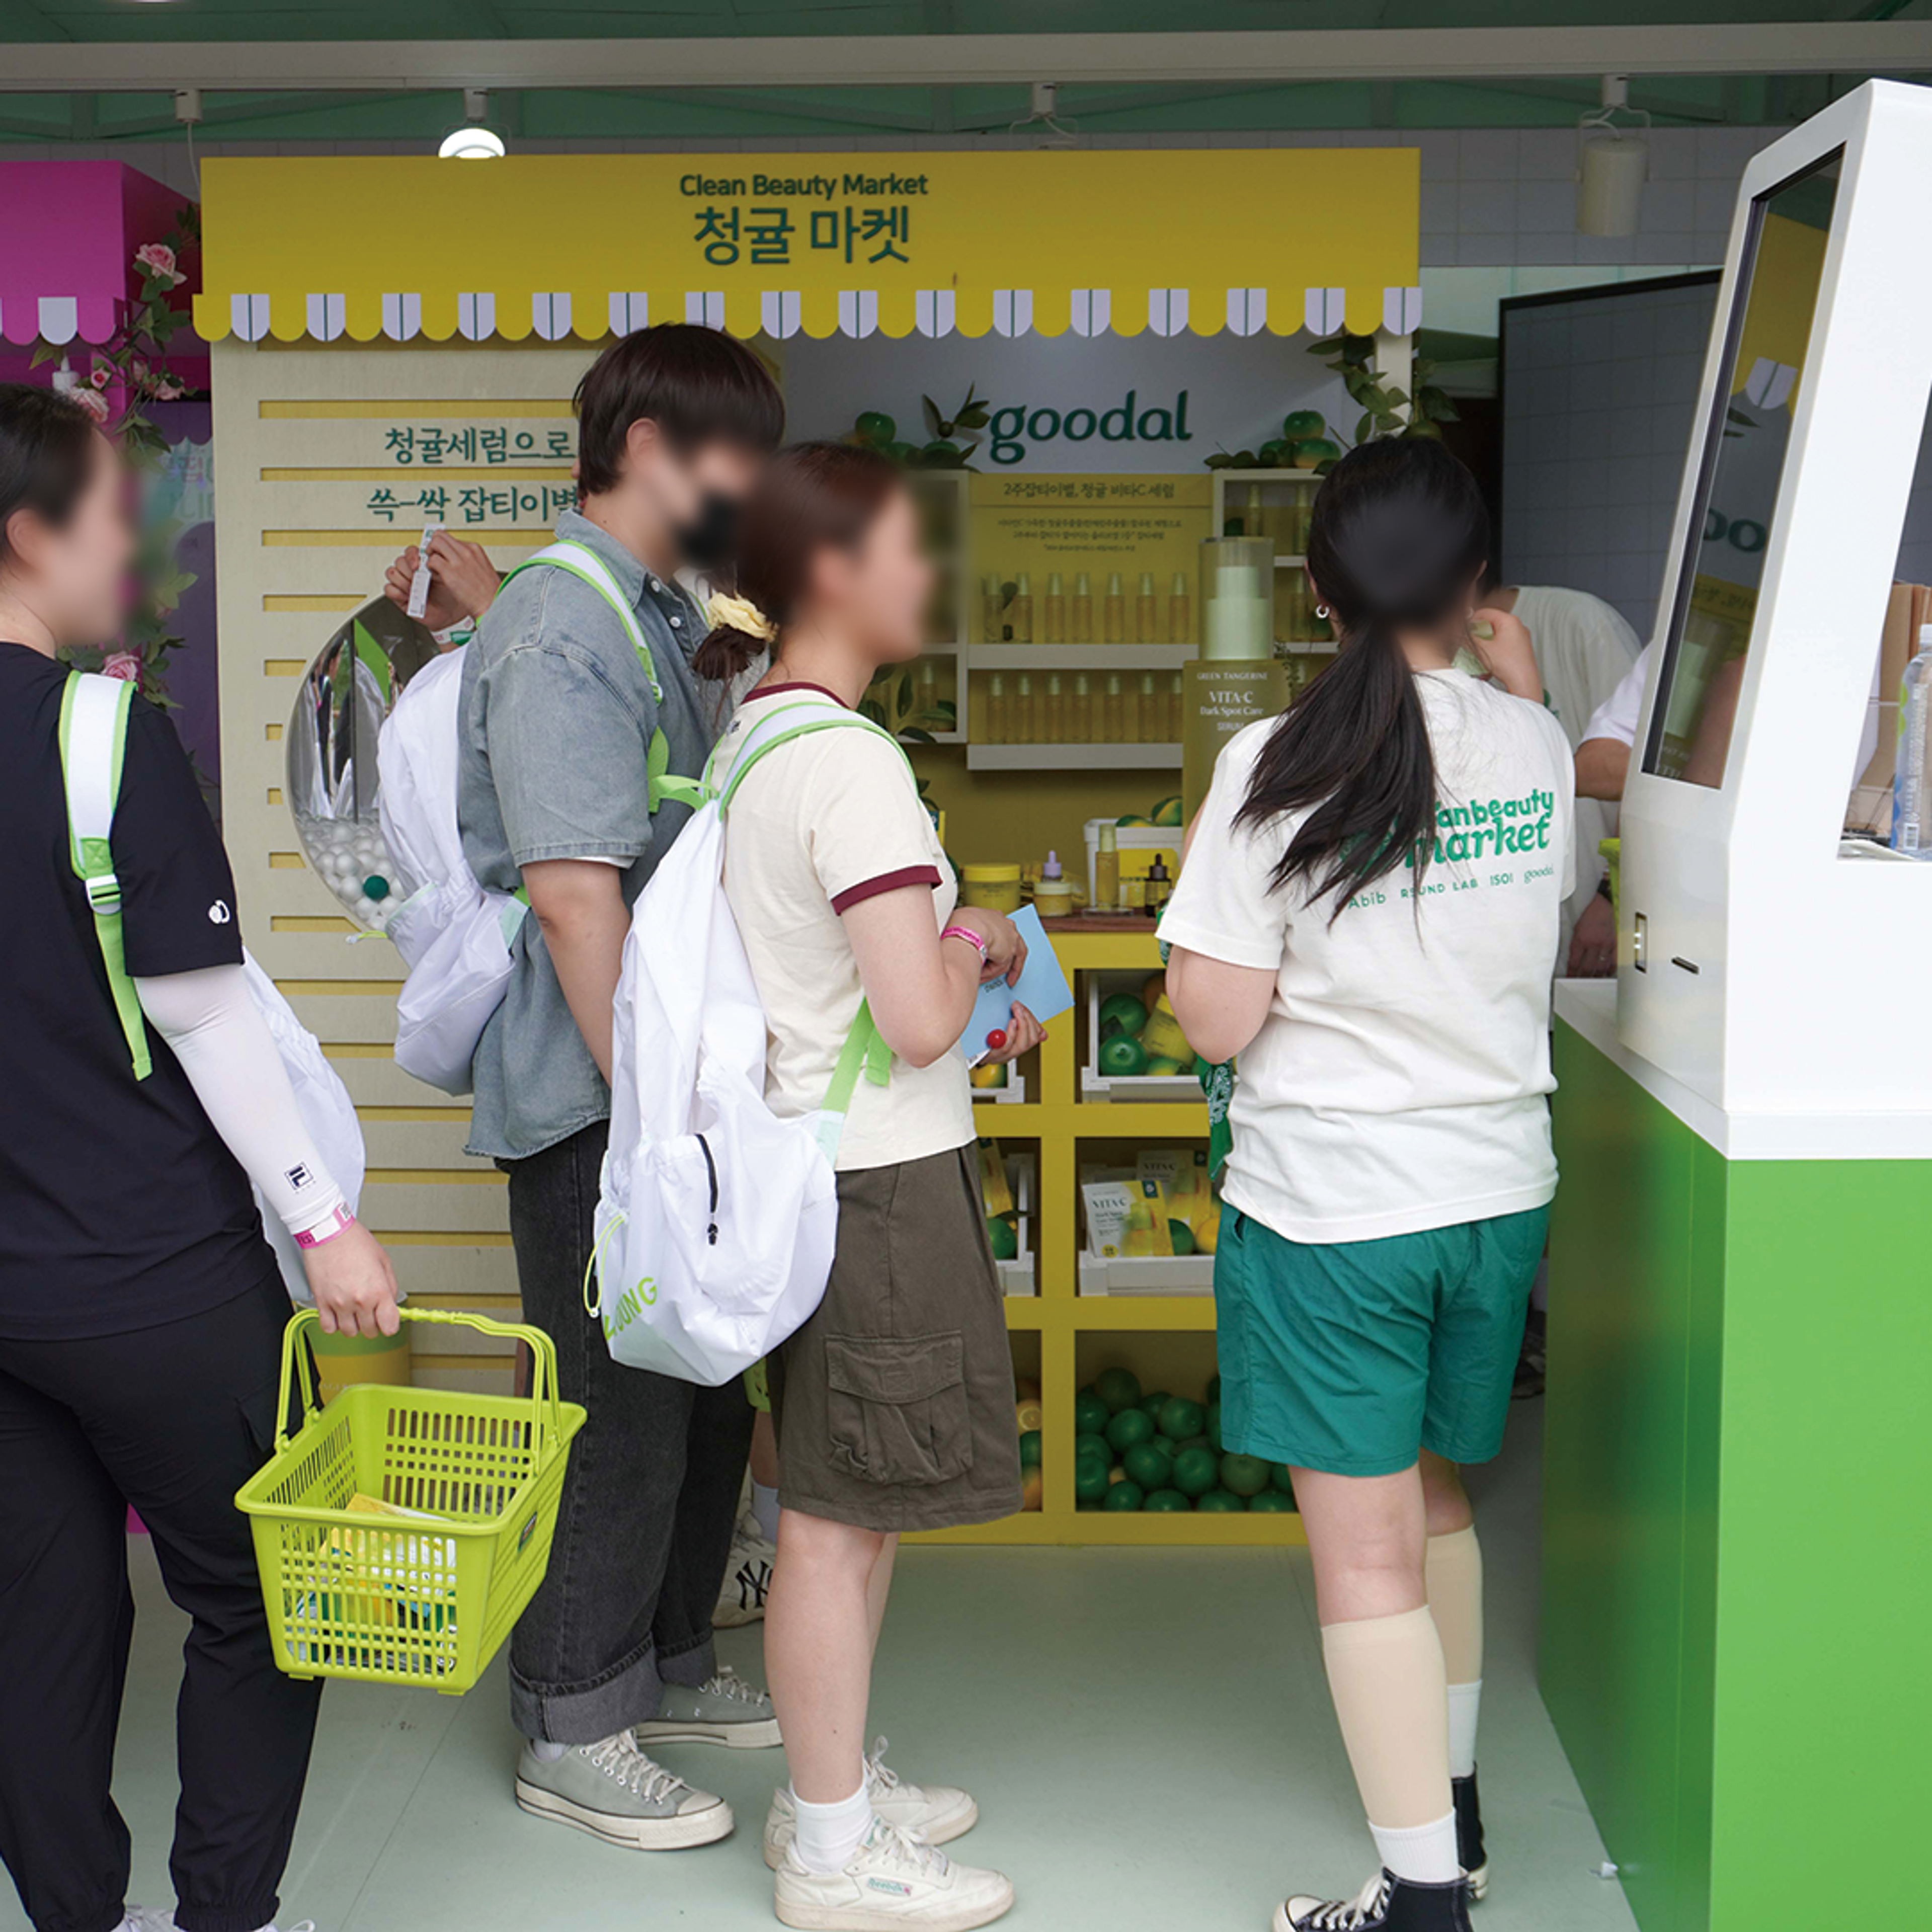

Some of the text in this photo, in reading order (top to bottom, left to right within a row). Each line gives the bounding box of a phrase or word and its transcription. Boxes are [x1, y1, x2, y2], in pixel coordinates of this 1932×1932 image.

[680, 173, 928, 200] Clean Beauty Market
[694, 206, 909, 265] 청귤 마켓
[990, 389, 1192, 464] goodal
[385, 427, 576, 463] 청귤세럼으로
[1081, 482, 1107, 498] 청귤
[1148, 483, 1175, 499] 세럼
[1200, 706, 1219, 715] Dark
[1435, 788, 1554, 828] anbeauty
[1348, 892, 1386, 909] Abib
[1453, 877, 1478, 892] LAB
